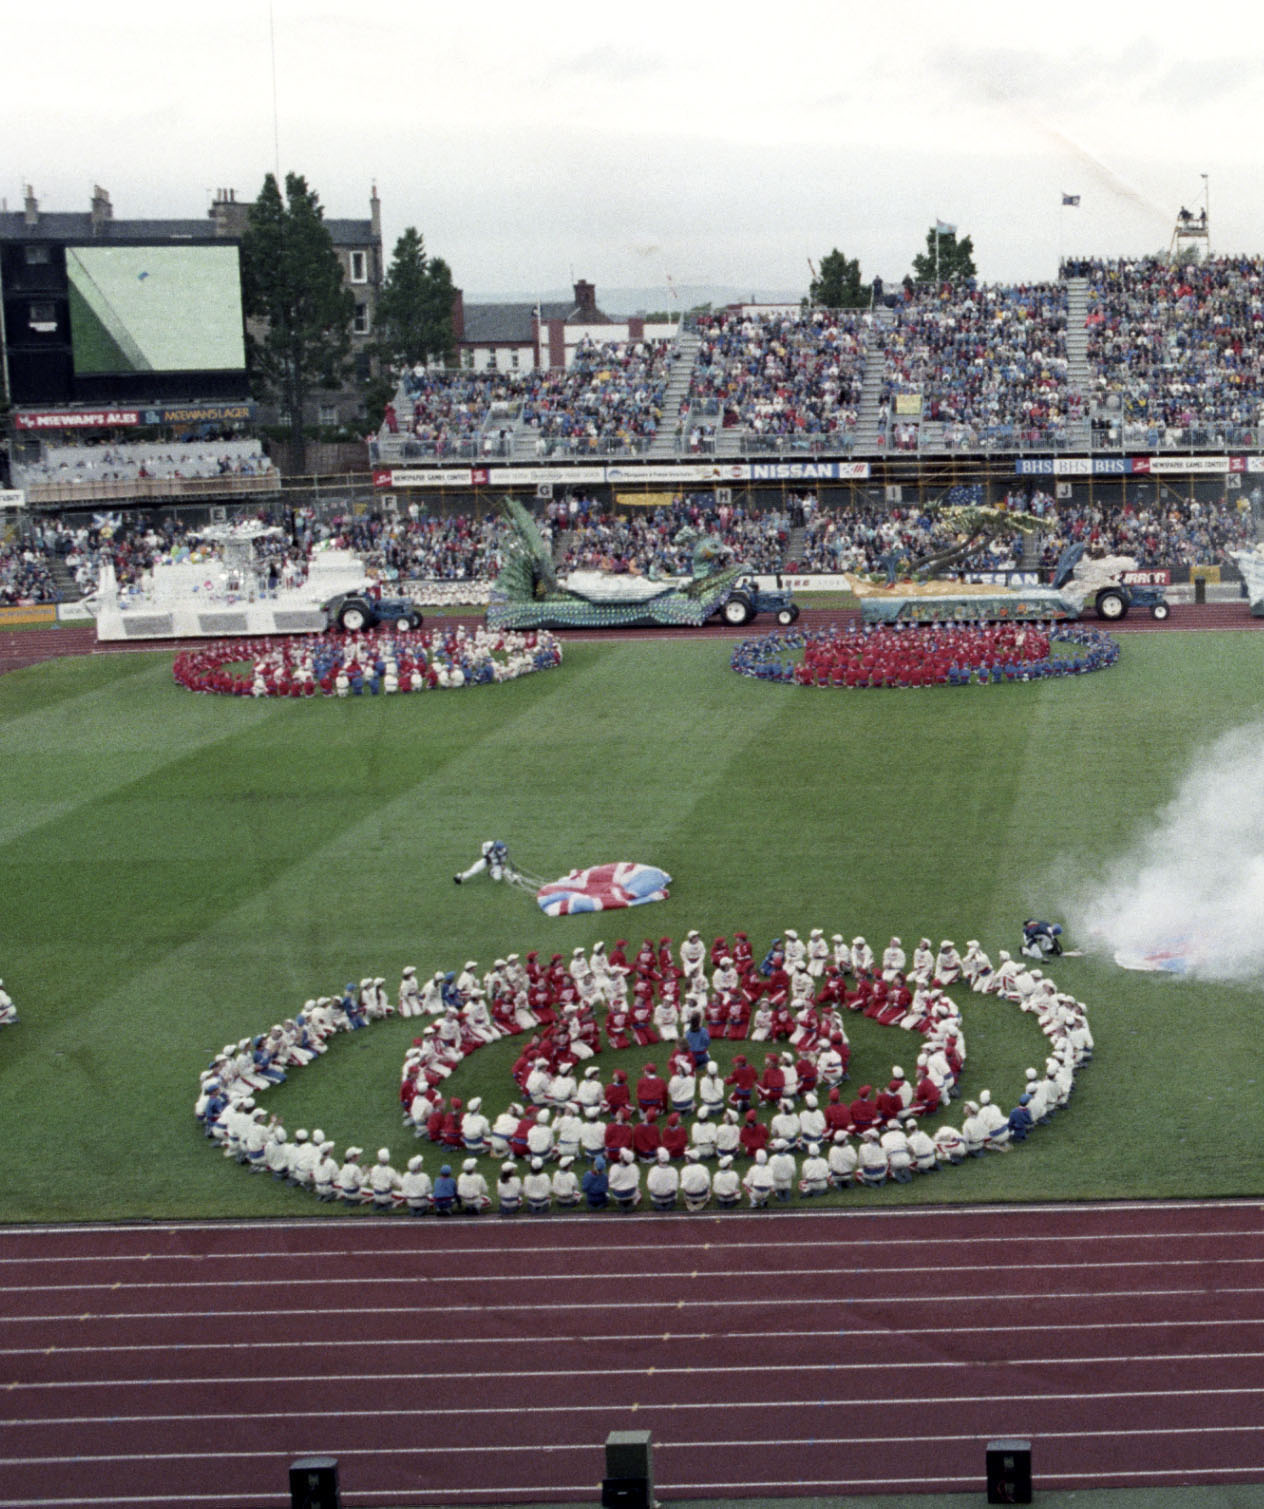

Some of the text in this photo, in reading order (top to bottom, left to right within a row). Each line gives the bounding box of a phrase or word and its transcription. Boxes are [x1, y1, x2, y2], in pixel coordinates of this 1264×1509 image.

[106, 413, 137, 424] ALES
[753, 463, 833, 478] NISSAN
[1022, 460, 1053, 473] BHS
[1059, 460, 1088, 473] BHS
[1095, 460, 1125, 473] BHS
[1151, 461, 1183, 469] NEWSPAPER
[394, 473, 425, 481] NEWSPAPER
[446, 472, 470, 480] CONTEST
[1227, 475, 1238, 487] K
[539, 485, 550, 496] G
[720, 488, 730, 501] H
[1060, 482, 1069, 496] J
[385, 497, 394, 507] F
